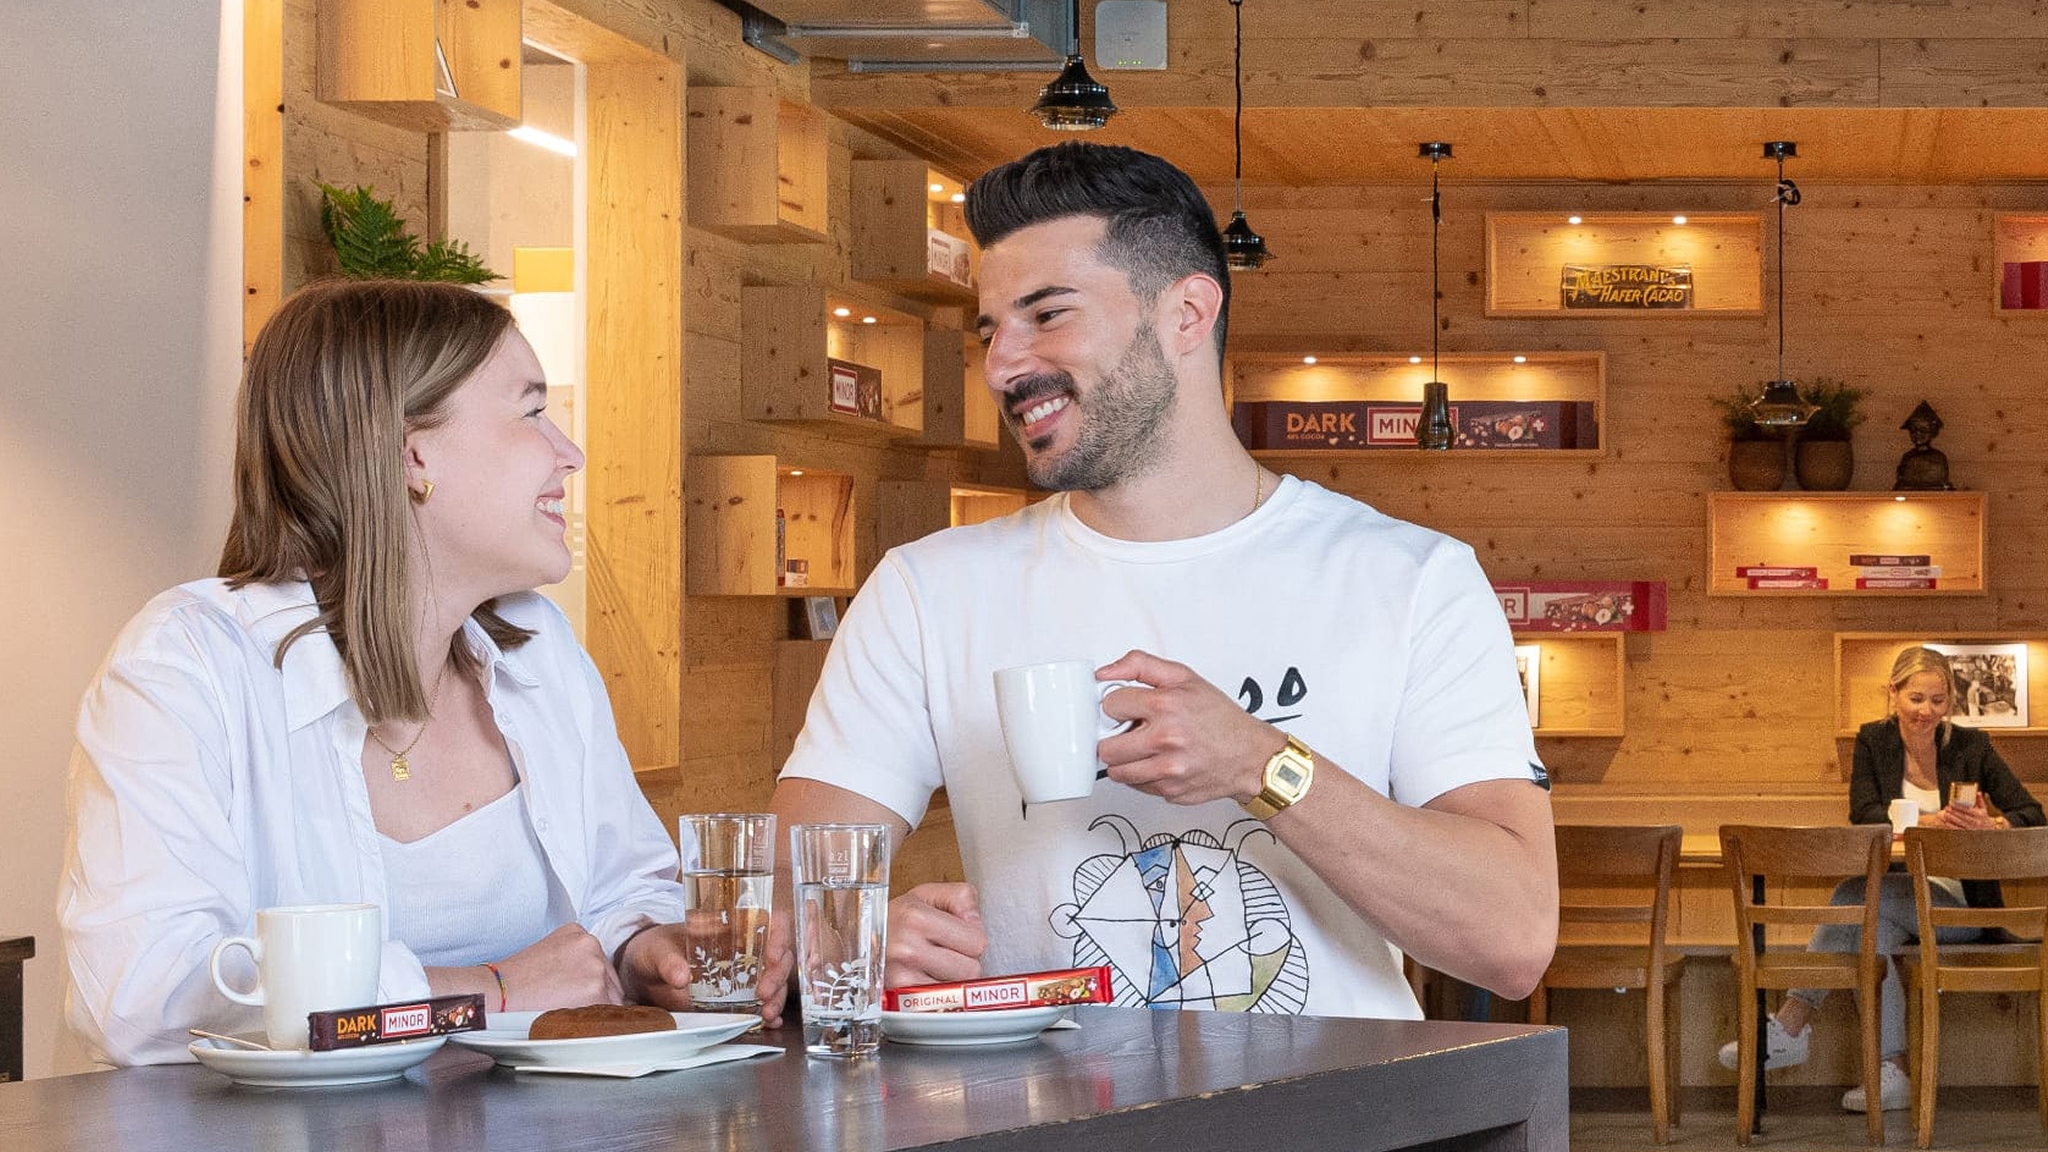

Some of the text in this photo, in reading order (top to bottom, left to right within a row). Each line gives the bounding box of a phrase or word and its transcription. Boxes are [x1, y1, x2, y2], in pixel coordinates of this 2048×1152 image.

[836, 380, 854, 400] MINOR
[1286, 413, 1417, 434] DARK MIN
[903, 987, 1020, 1008] ORIGINAL MINOR
[337, 1013, 425, 1034] DARK MINOR
